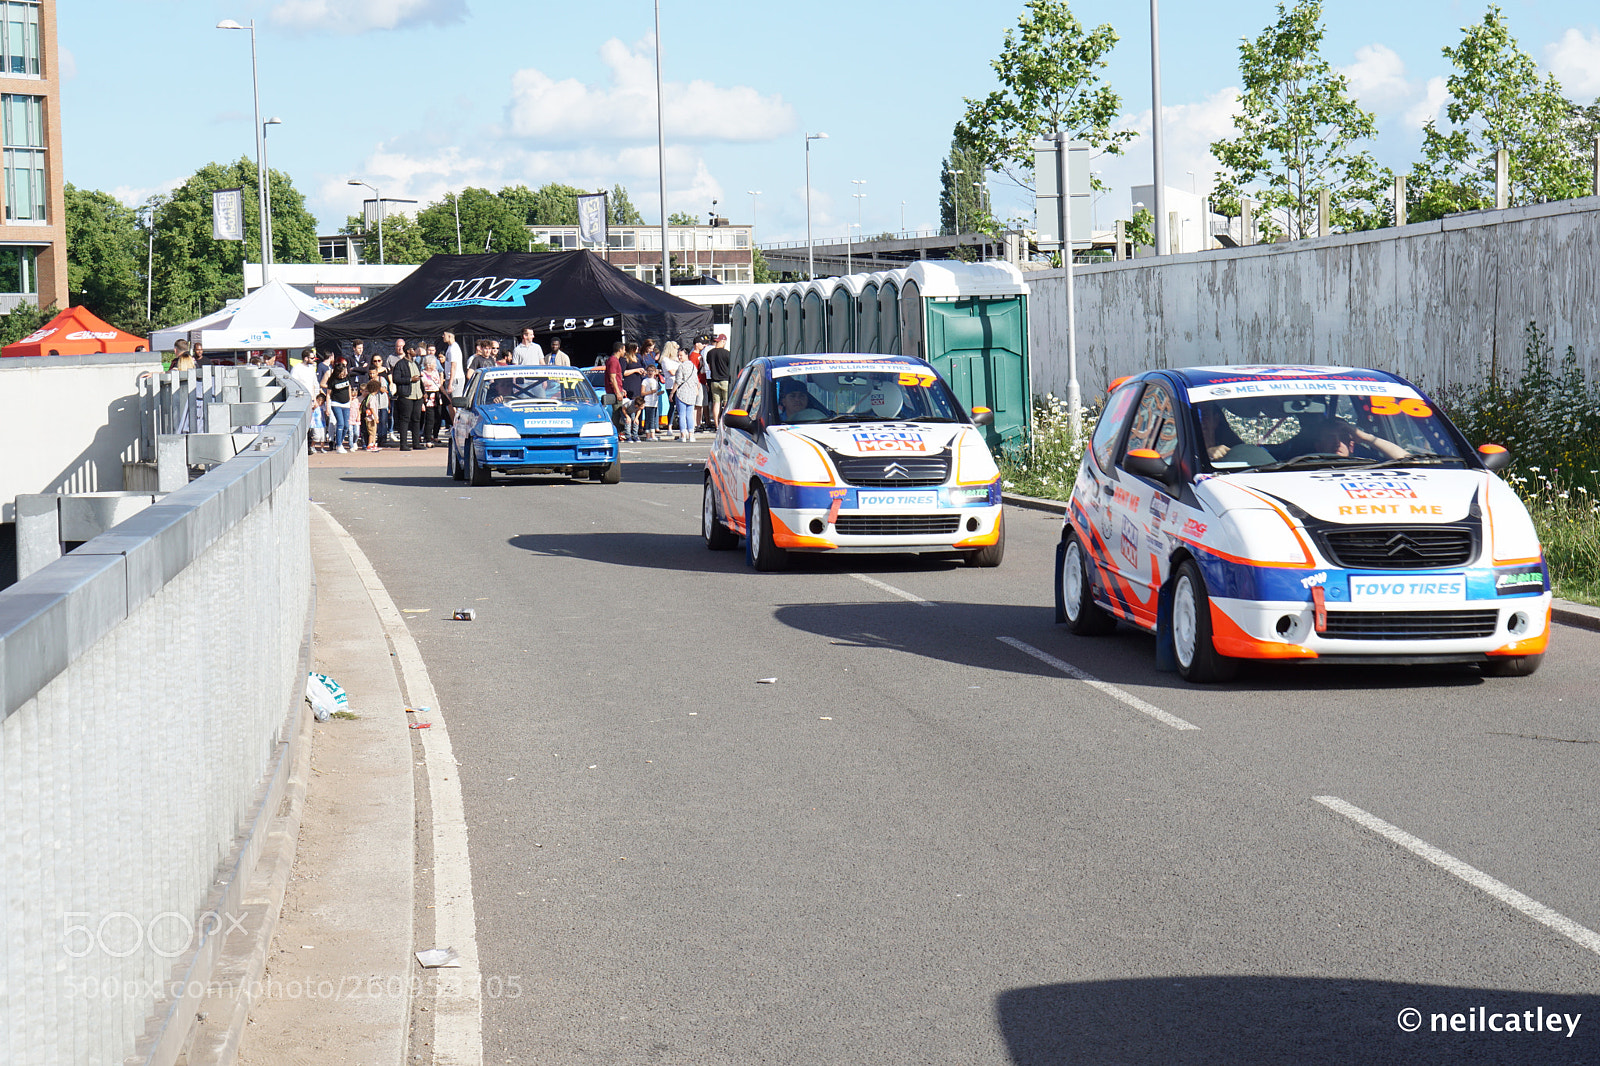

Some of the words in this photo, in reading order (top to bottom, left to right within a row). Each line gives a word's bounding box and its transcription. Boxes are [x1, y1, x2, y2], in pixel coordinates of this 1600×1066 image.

[432, 276, 542, 306] MMR
[559, 378, 579, 390] 17
[898, 372, 938, 388] 57
[1208, 374, 1378, 384] www.jdgarage.co.uk
[1236, 385, 1264, 394] MEL
[1268, 382, 1337, 392] WILLIAMS
[1342, 383, 1388, 394] TYRES
[1369, 395, 1433, 418] 56
[854, 433, 922, 441] LIQUI
[858, 441, 925, 451] MOLY
[1342, 482, 1411, 490] LIQUI
[828, 488, 848, 497] TOW
[1347, 489, 1415, 499] MOLY
[861, 495, 895, 505] TOYO
[898, 495, 934, 504] TIRES
[1112, 485, 1130, 508] RENT
[1127, 493, 1141, 514] ME
[1338, 504, 1400, 516] RENT
[1409, 504, 1444, 515] ME
[1183, 517, 1208, 534] JDG
[1300, 571, 1328, 589] TOW
[1355, 583, 1404, 595] TOYO
[1407, 582, 1461, 595] TIRES
